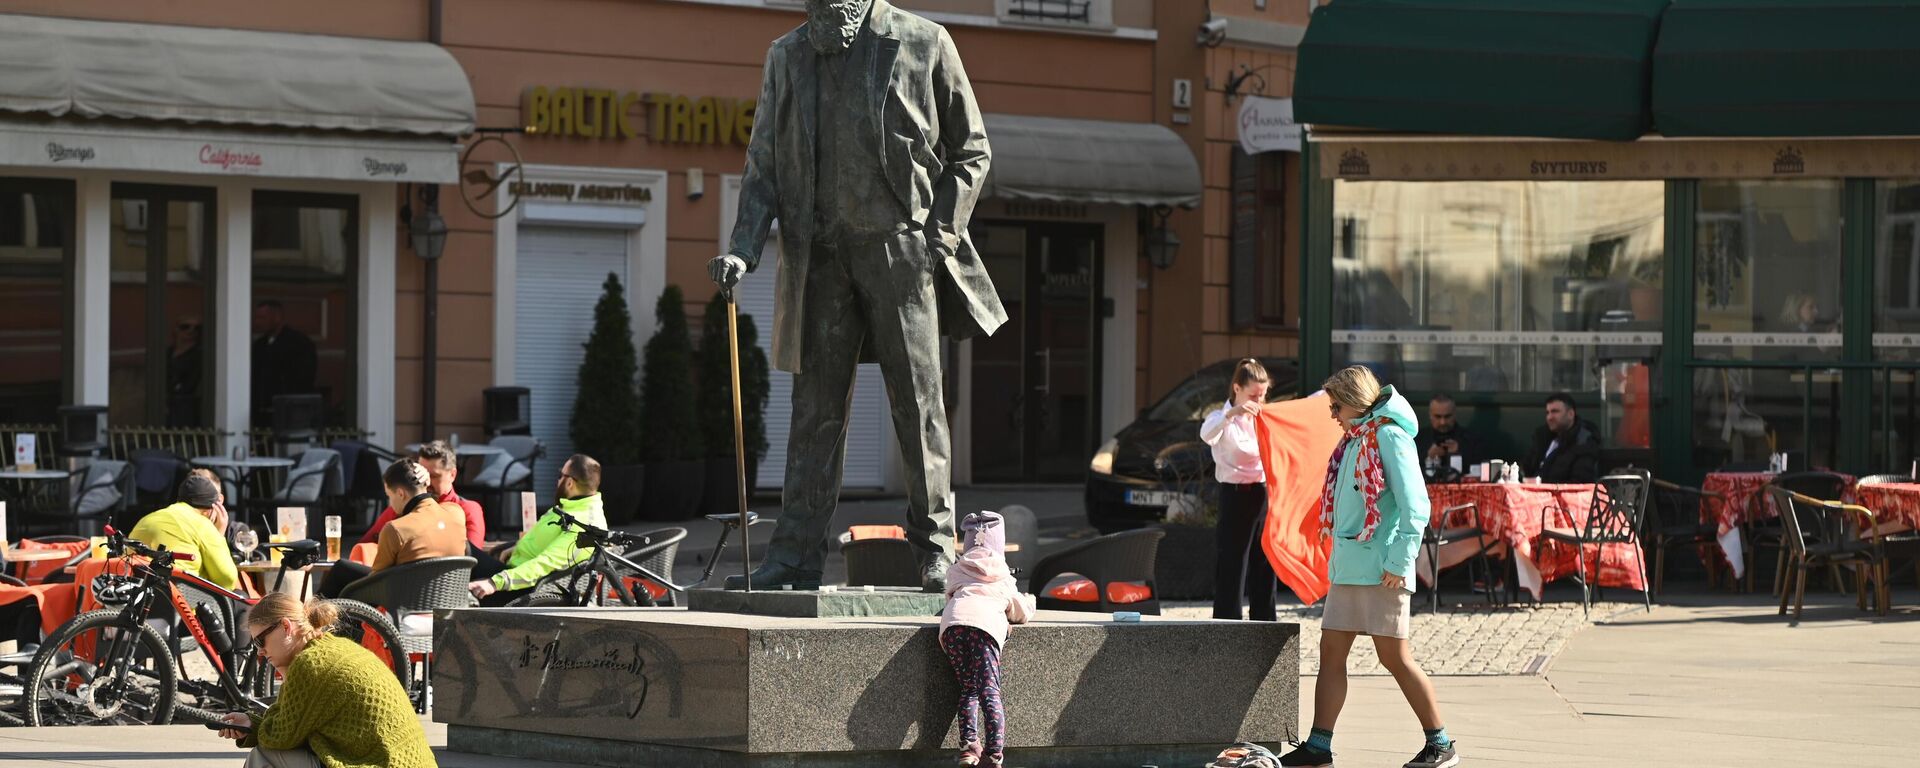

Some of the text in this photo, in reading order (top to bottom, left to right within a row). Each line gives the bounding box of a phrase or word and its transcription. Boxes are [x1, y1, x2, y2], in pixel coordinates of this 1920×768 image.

[528, 85, 754, 146] BALTIC TRAVE
[1241, 106, 1294, 128] HARMO
[199, 144, 262, 169] California
[1530, 158, 1608, 174] ŠVYTURYS
[1132, 492, 1153, 504] MNT
